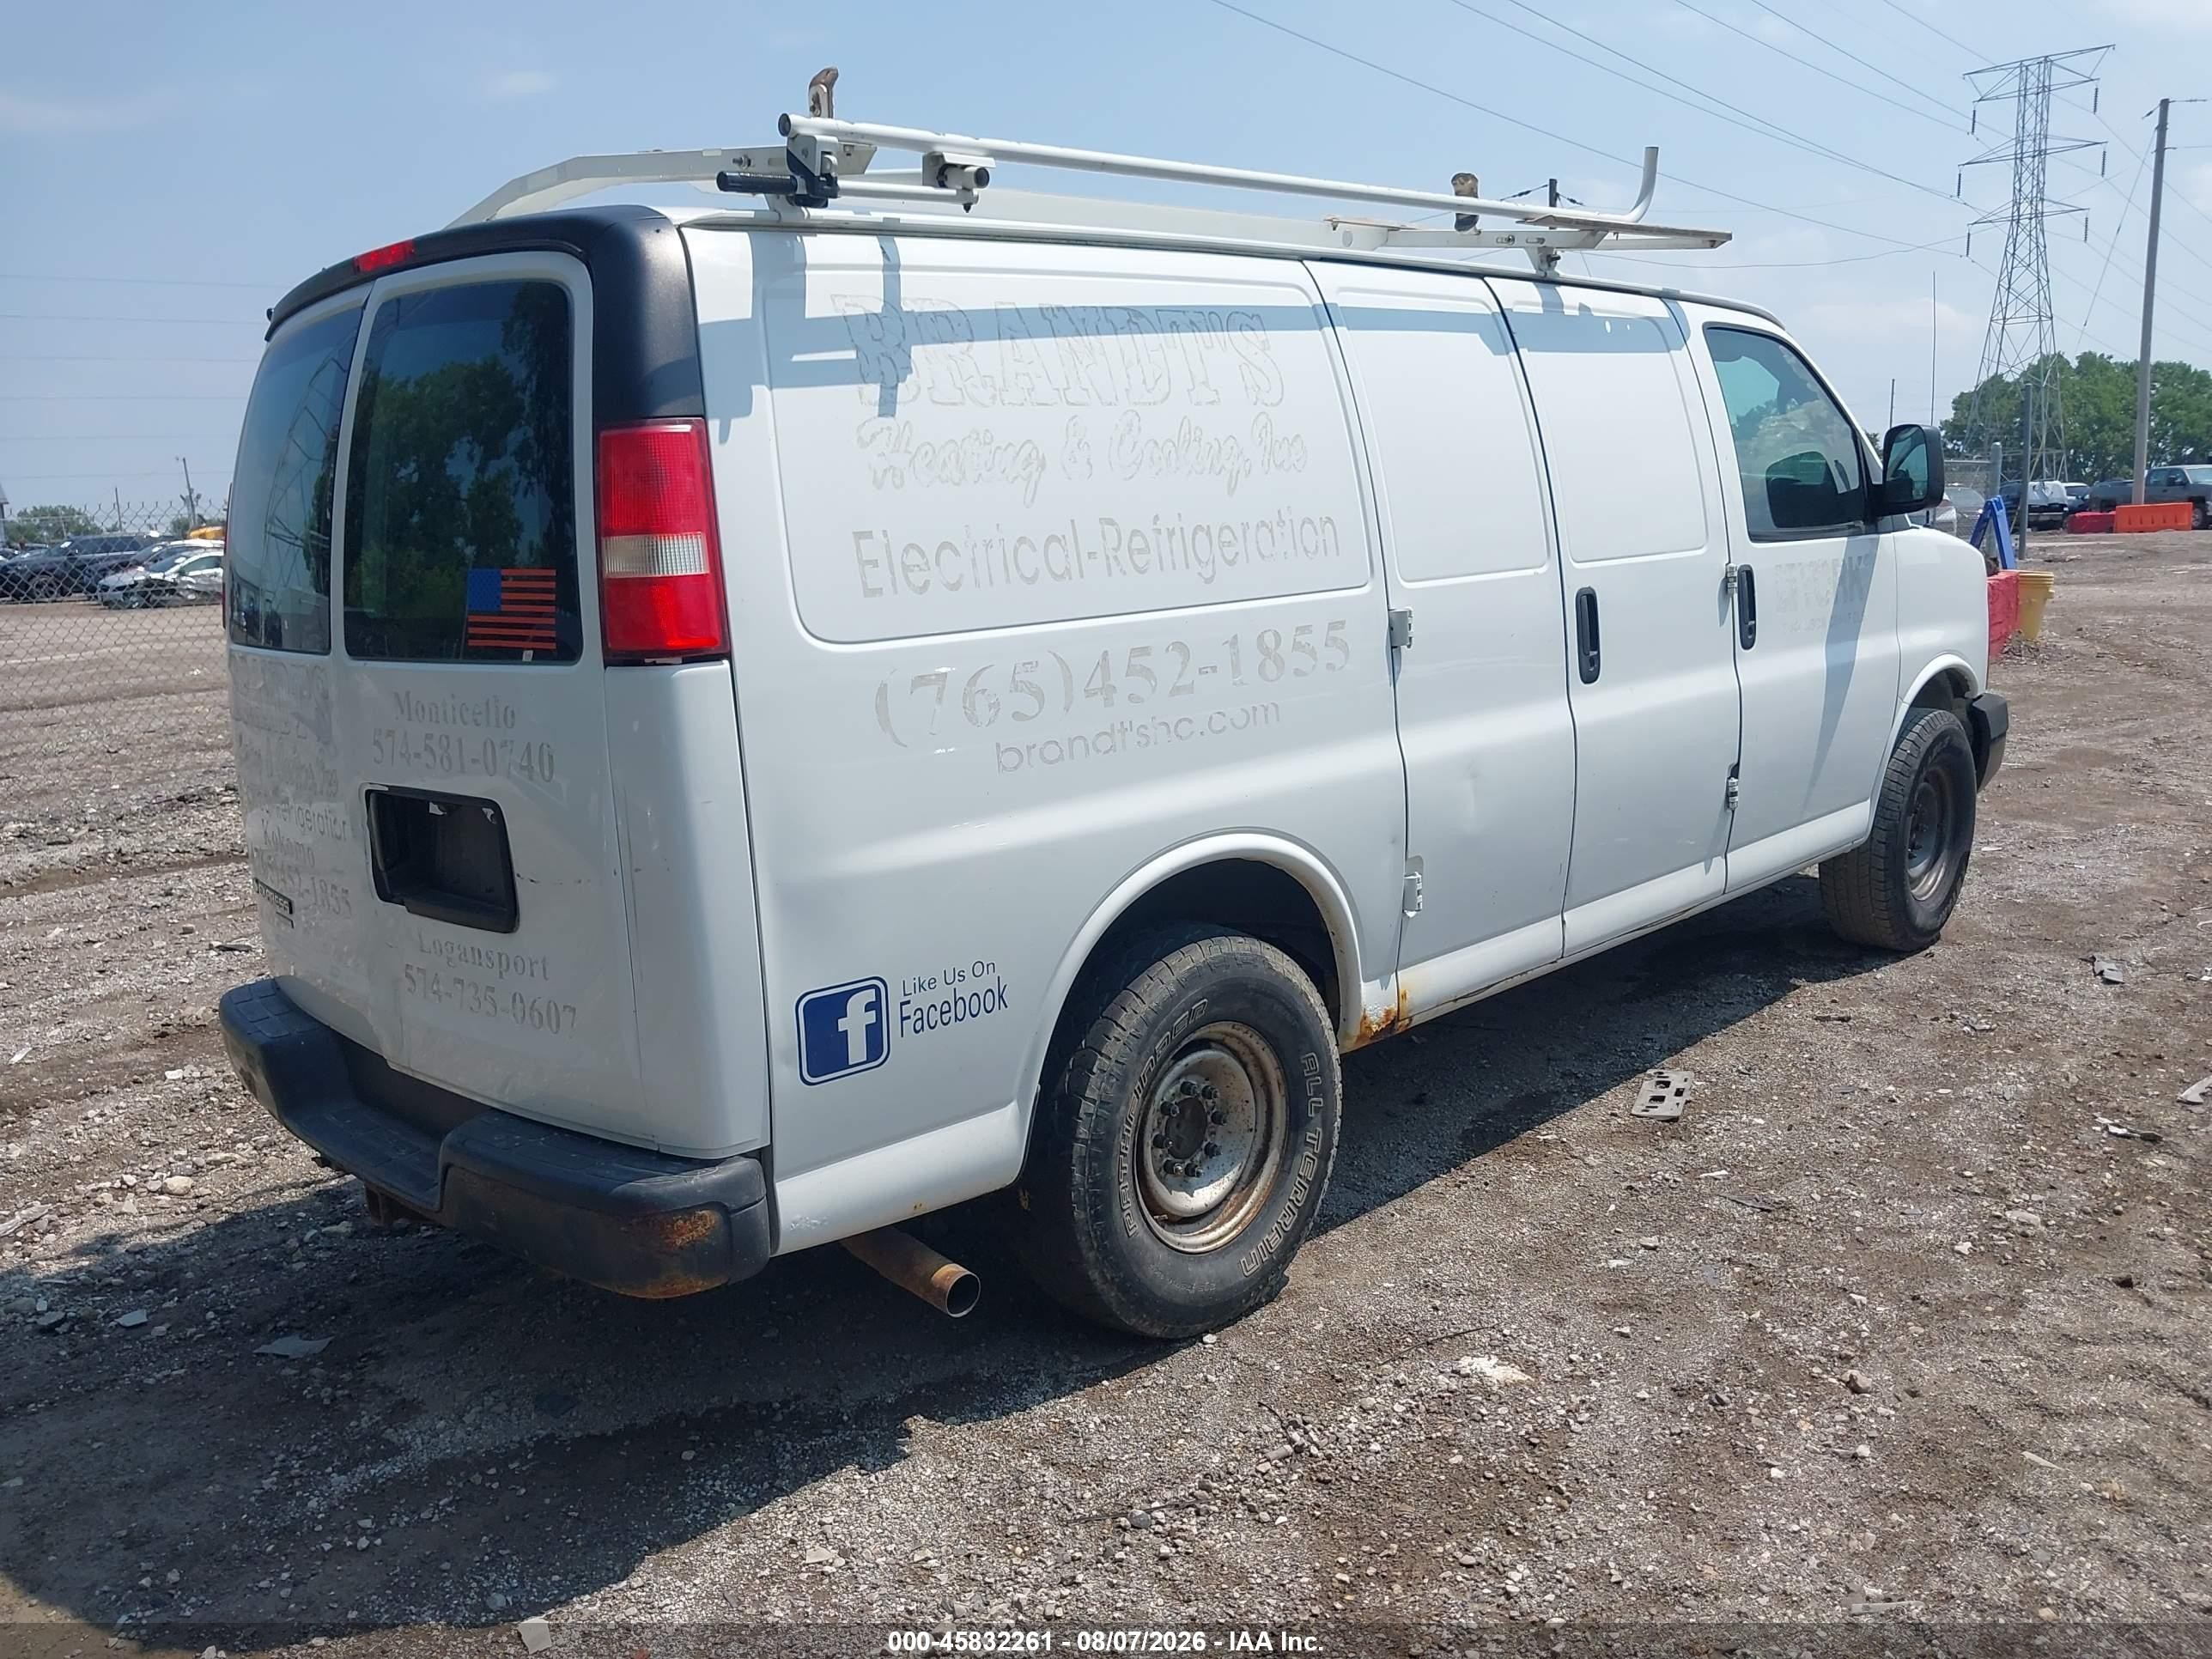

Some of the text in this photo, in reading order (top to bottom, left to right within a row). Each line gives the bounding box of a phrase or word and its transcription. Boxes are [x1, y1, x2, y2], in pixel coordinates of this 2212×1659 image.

[852, 506, 1341, 599] Electrical-Refrigeration
[392, 690, 516, 730] Monticello
[875, 619, 1352, 749] (765)452-1855
[372, 727, 556, 783] 574-581-0740
[995, 701, 1281, 774] brandt'shc.com
[417, 927, 550, 981] Logansport
[902, 960, 996, 998] Like Us On
[404, 963, 578, 1037] 574-735-0607
[899, 975, 1009, 1038] Facebook
[1239, 1051, 1325, 1278] ALL TERRAIN
